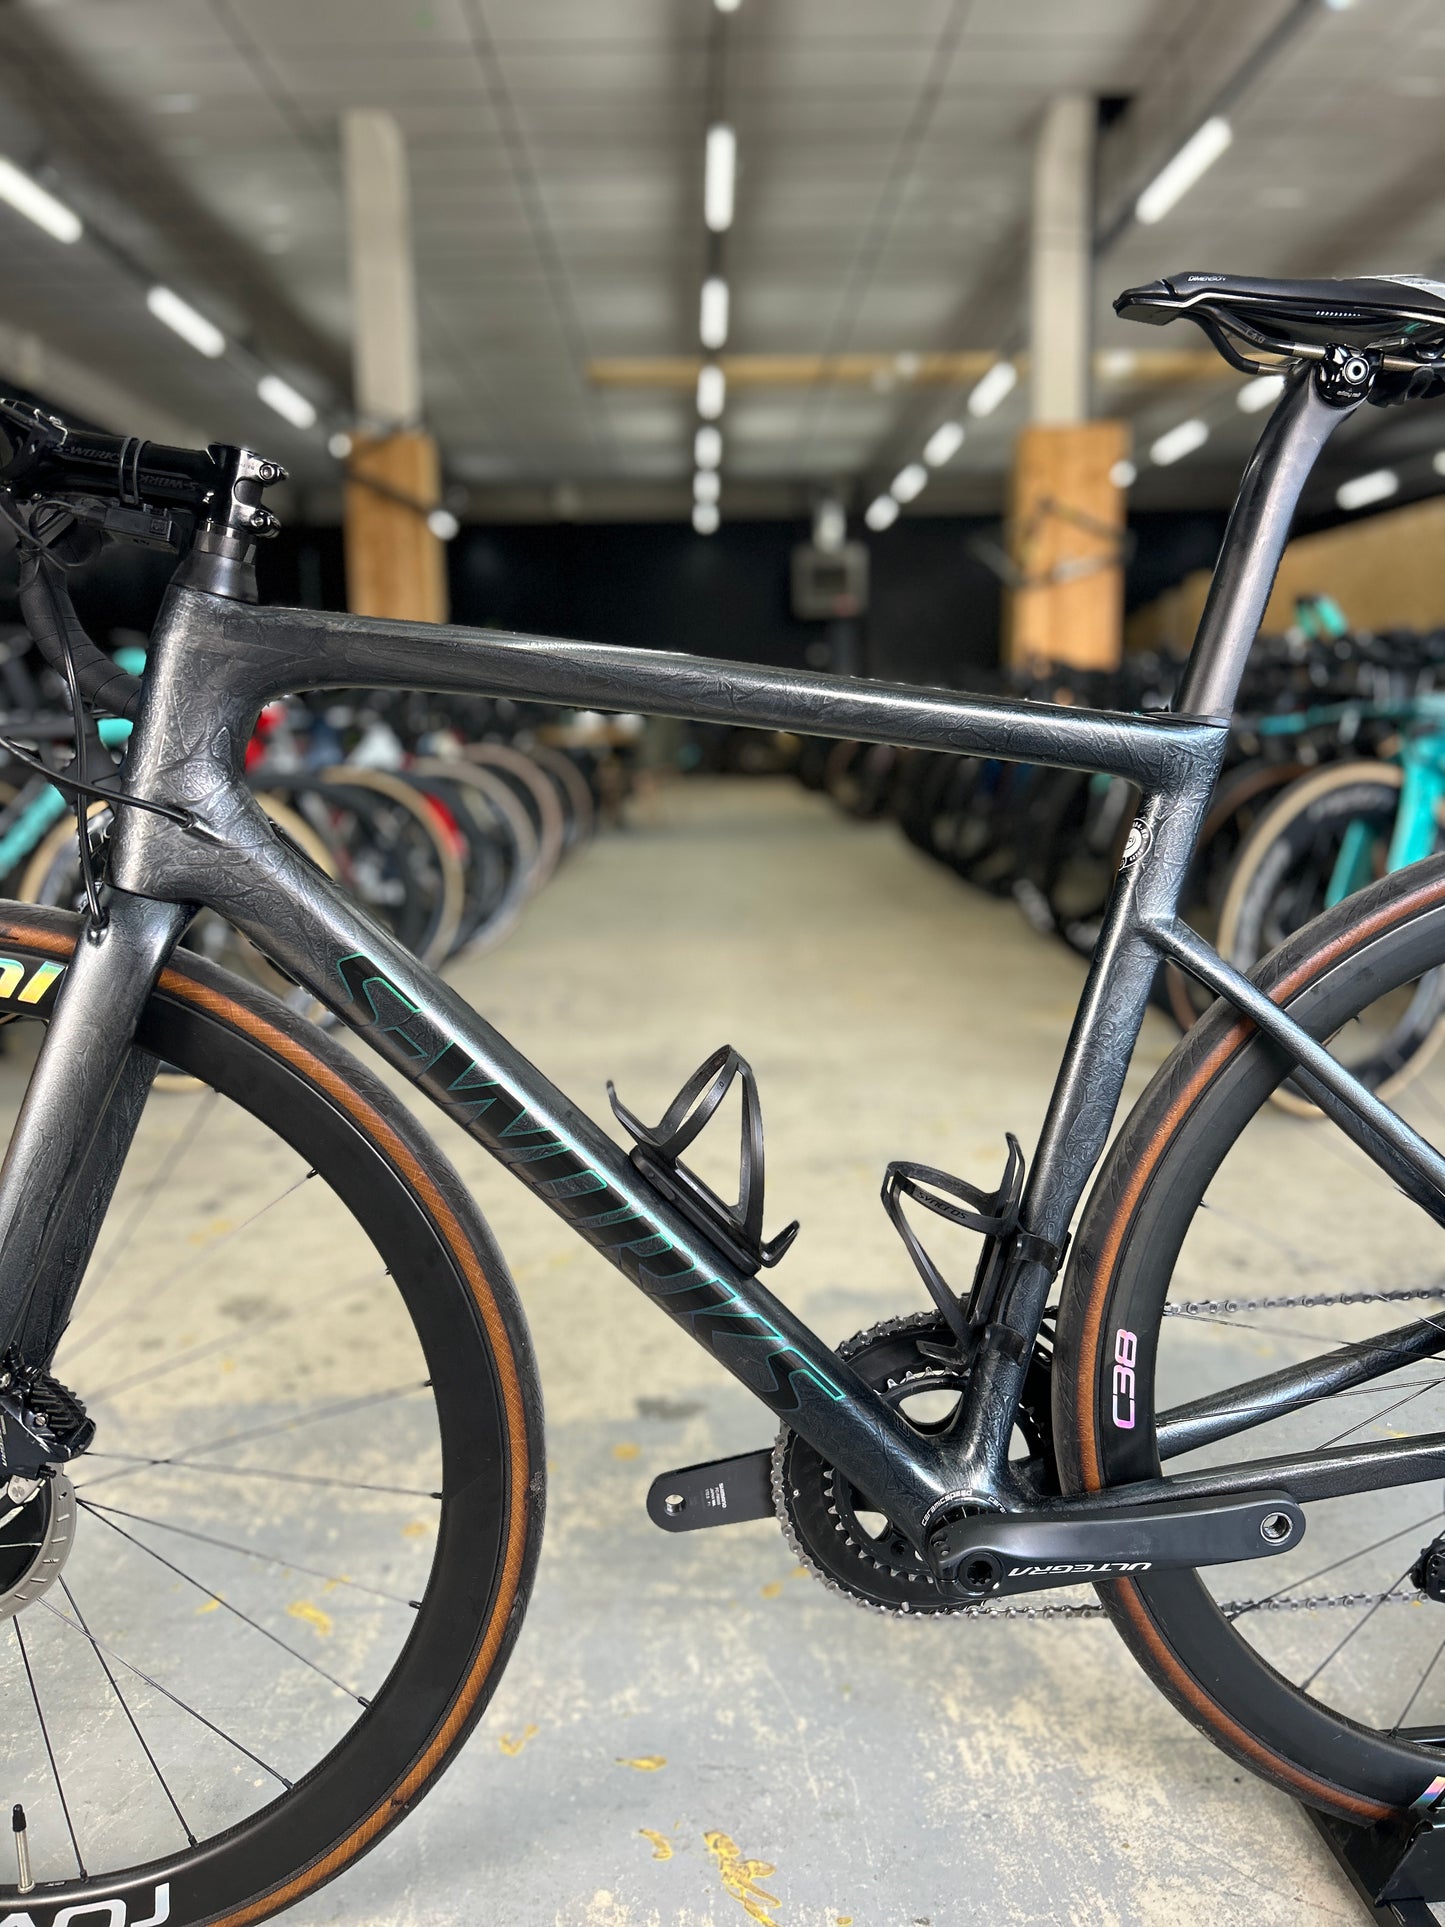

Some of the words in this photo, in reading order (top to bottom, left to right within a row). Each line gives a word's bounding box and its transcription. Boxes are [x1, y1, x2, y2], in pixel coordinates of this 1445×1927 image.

[337, 952, 847, 1412] S-WORKS
[1112, 1328, 1138, 1429] C38
[921, 1488, 973, 1527] ceramicspeed
[1007, 1561, 1152, 1577] ULTEGRA
